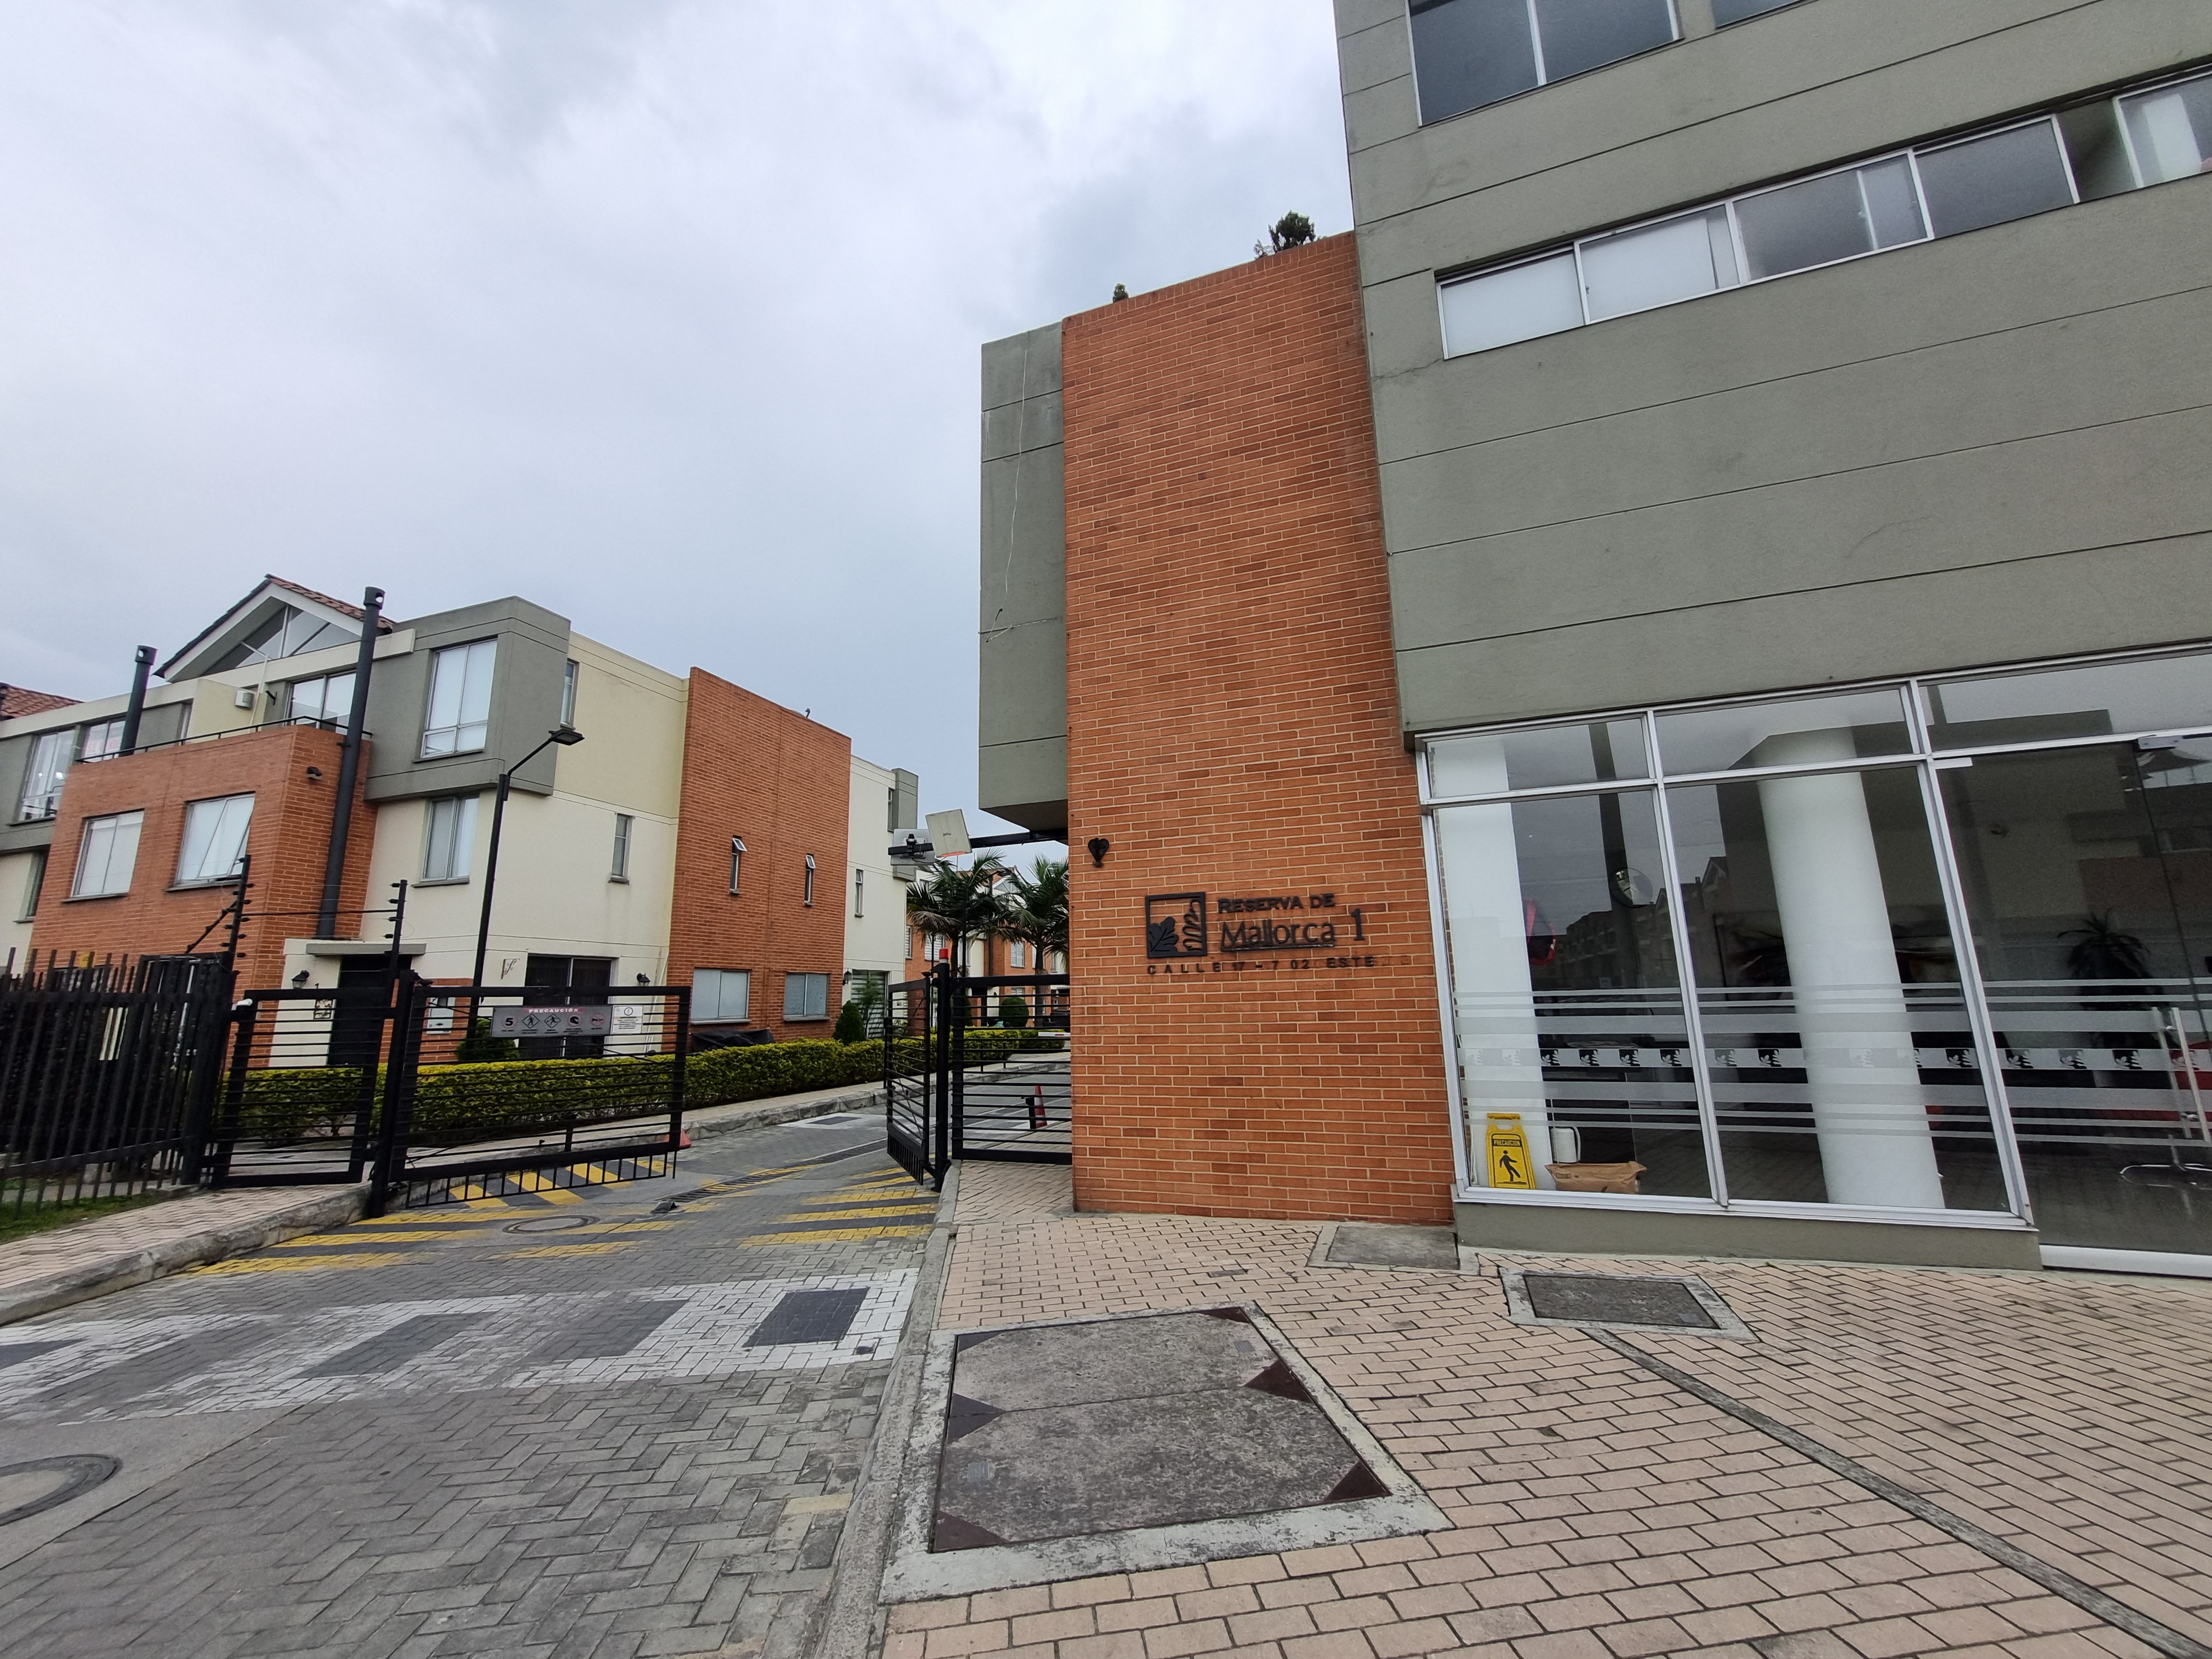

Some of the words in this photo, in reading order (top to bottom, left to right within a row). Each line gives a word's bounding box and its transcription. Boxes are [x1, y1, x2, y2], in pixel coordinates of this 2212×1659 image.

[1218, 896, 1304, 914] RESERVA
[1310, 893, 1335, 908] DE
[1220, 919, 1336, 946] Mallorca
[1147, 962, 1221, 974] CALLE
[1327, 956, 1375, 968] ESTE
[505, 1017, 514, 1026] 5
